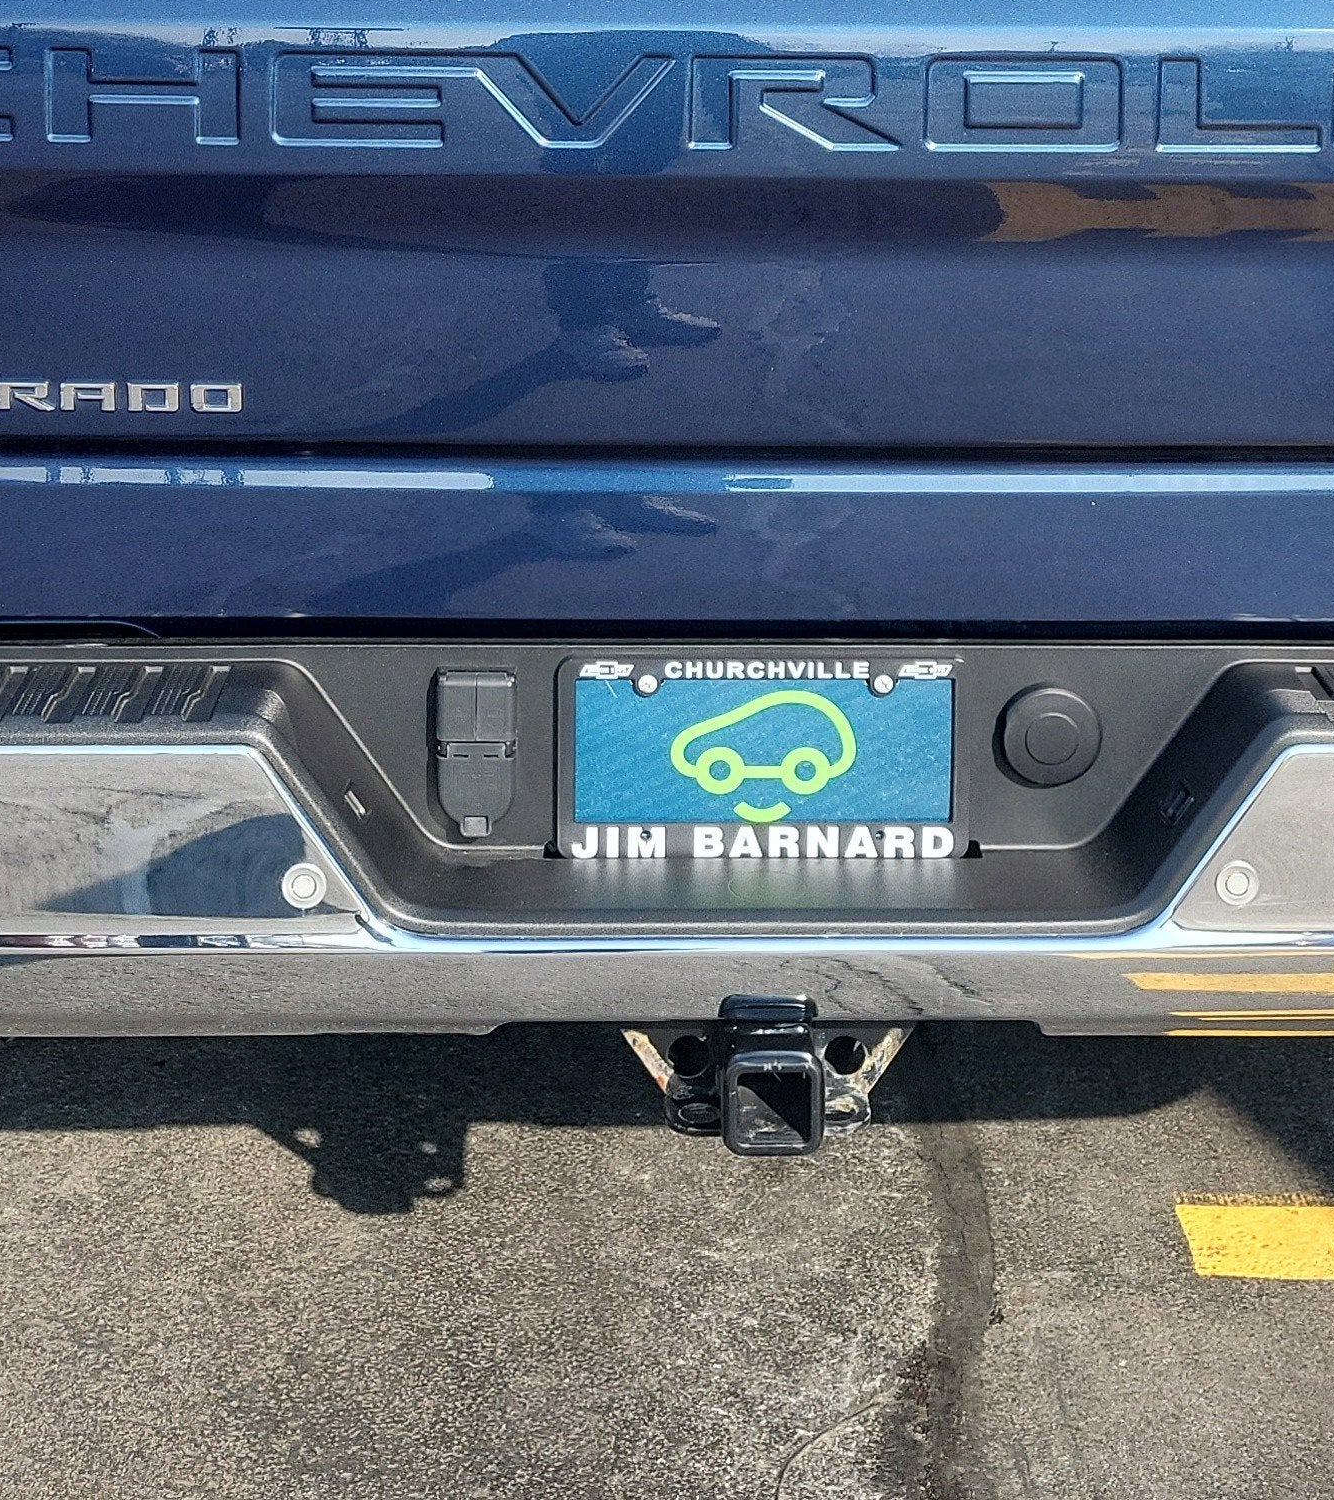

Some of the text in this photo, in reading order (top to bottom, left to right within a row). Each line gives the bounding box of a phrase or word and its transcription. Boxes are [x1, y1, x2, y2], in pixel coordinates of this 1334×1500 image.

[664, 660, 870, 680] CHURCHVILLE
[570, 825, 955, 859] JIM BARNARD
